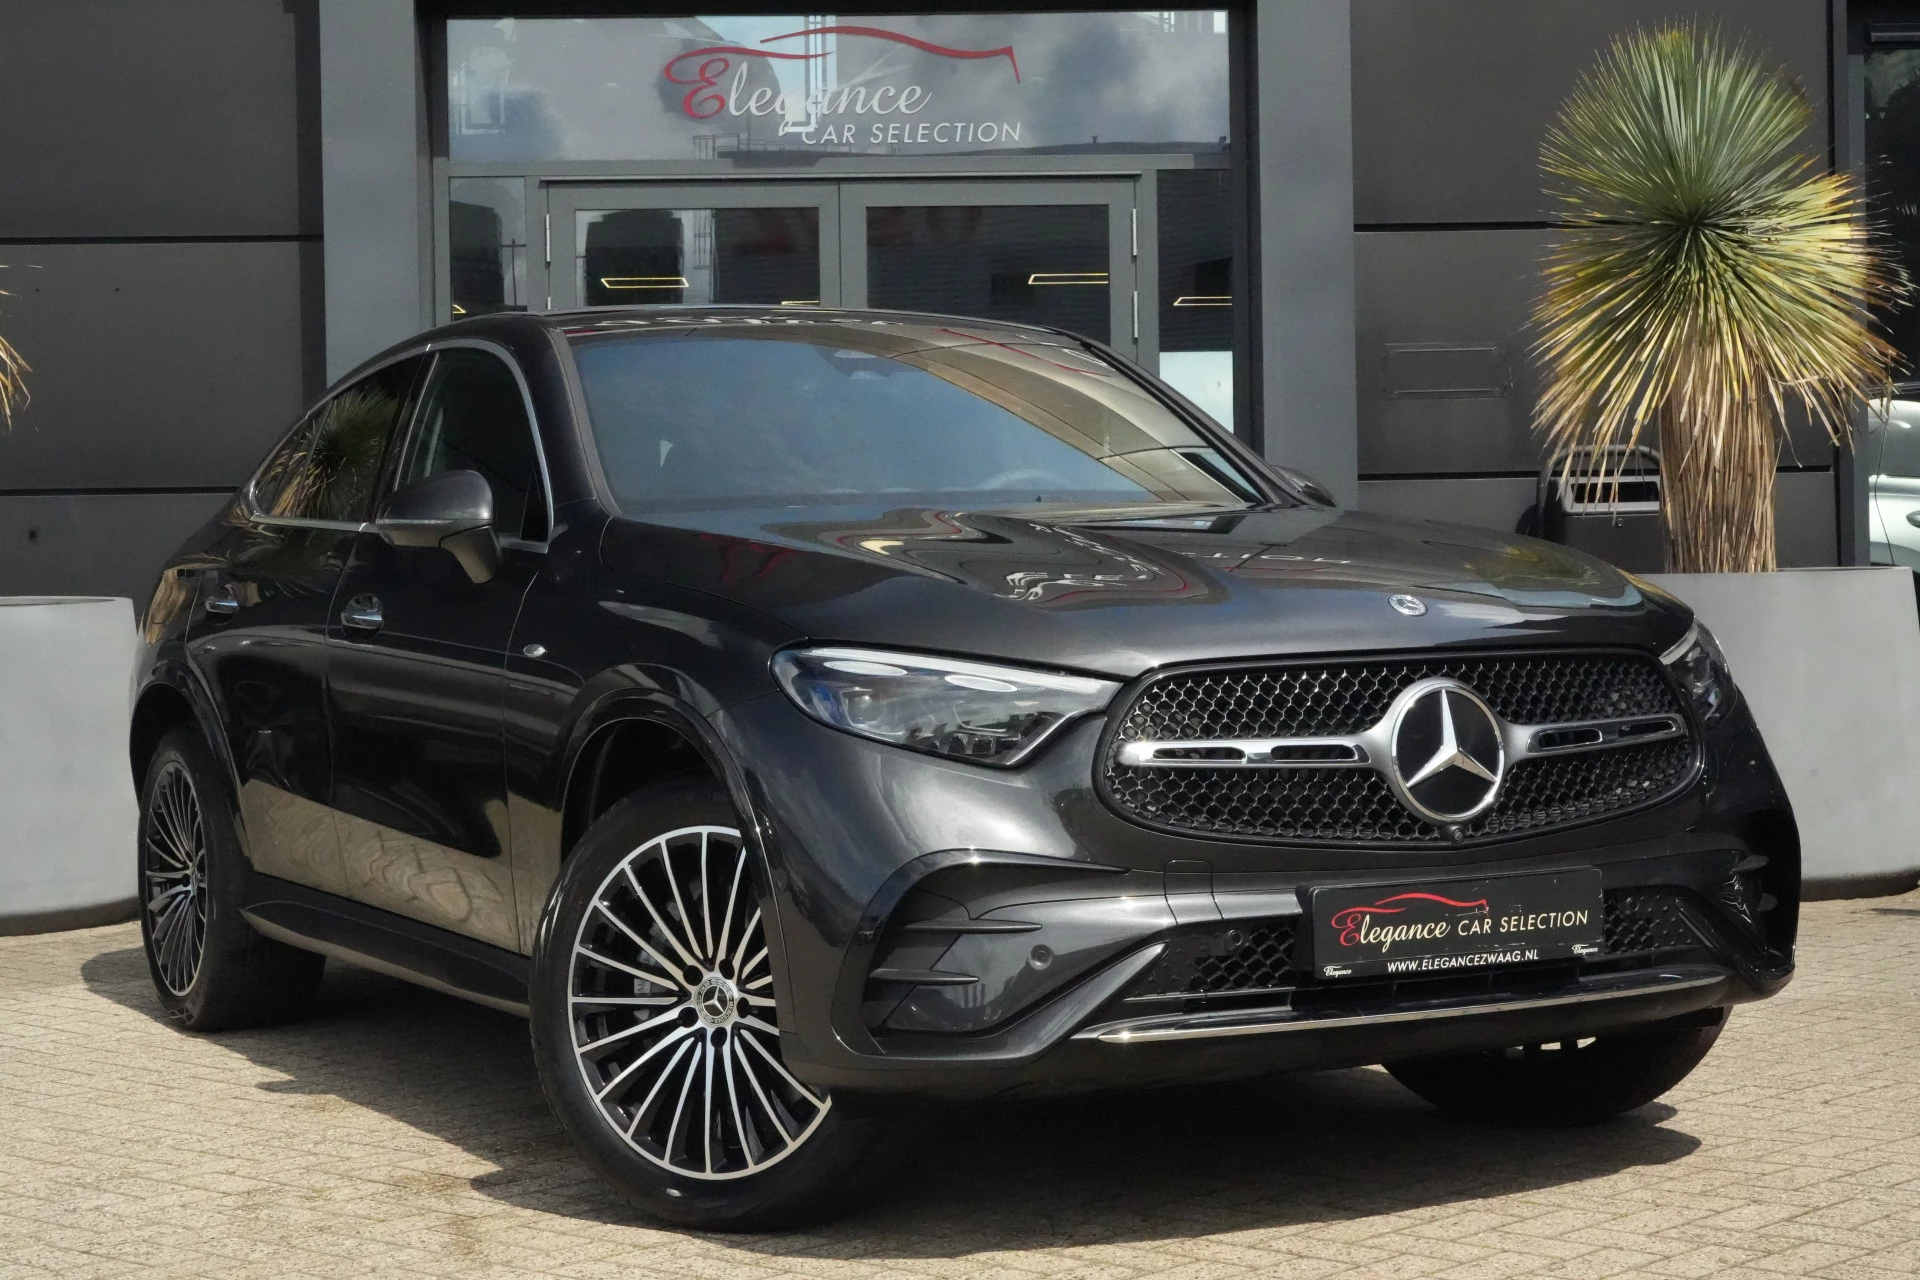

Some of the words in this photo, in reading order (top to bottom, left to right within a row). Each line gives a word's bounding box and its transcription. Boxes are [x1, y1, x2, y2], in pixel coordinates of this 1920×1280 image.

[664, 46, 932, 137] Elegance
[802, 122, 855, 145] CAR
[869, 121, 1021, 144] SELECTION
[1331, 907, 1451, 953] Elegance
[1457, 918, 1492, 936] CAR
[1499, 909, 1588, 933] SELECTION
[1387, 949, 1539, 973] WWW.ELEGANCEZWAAG.NL
[1571, 943, 1599, 956] Elegance
[1323, 965, 1352, 978] Elegance
